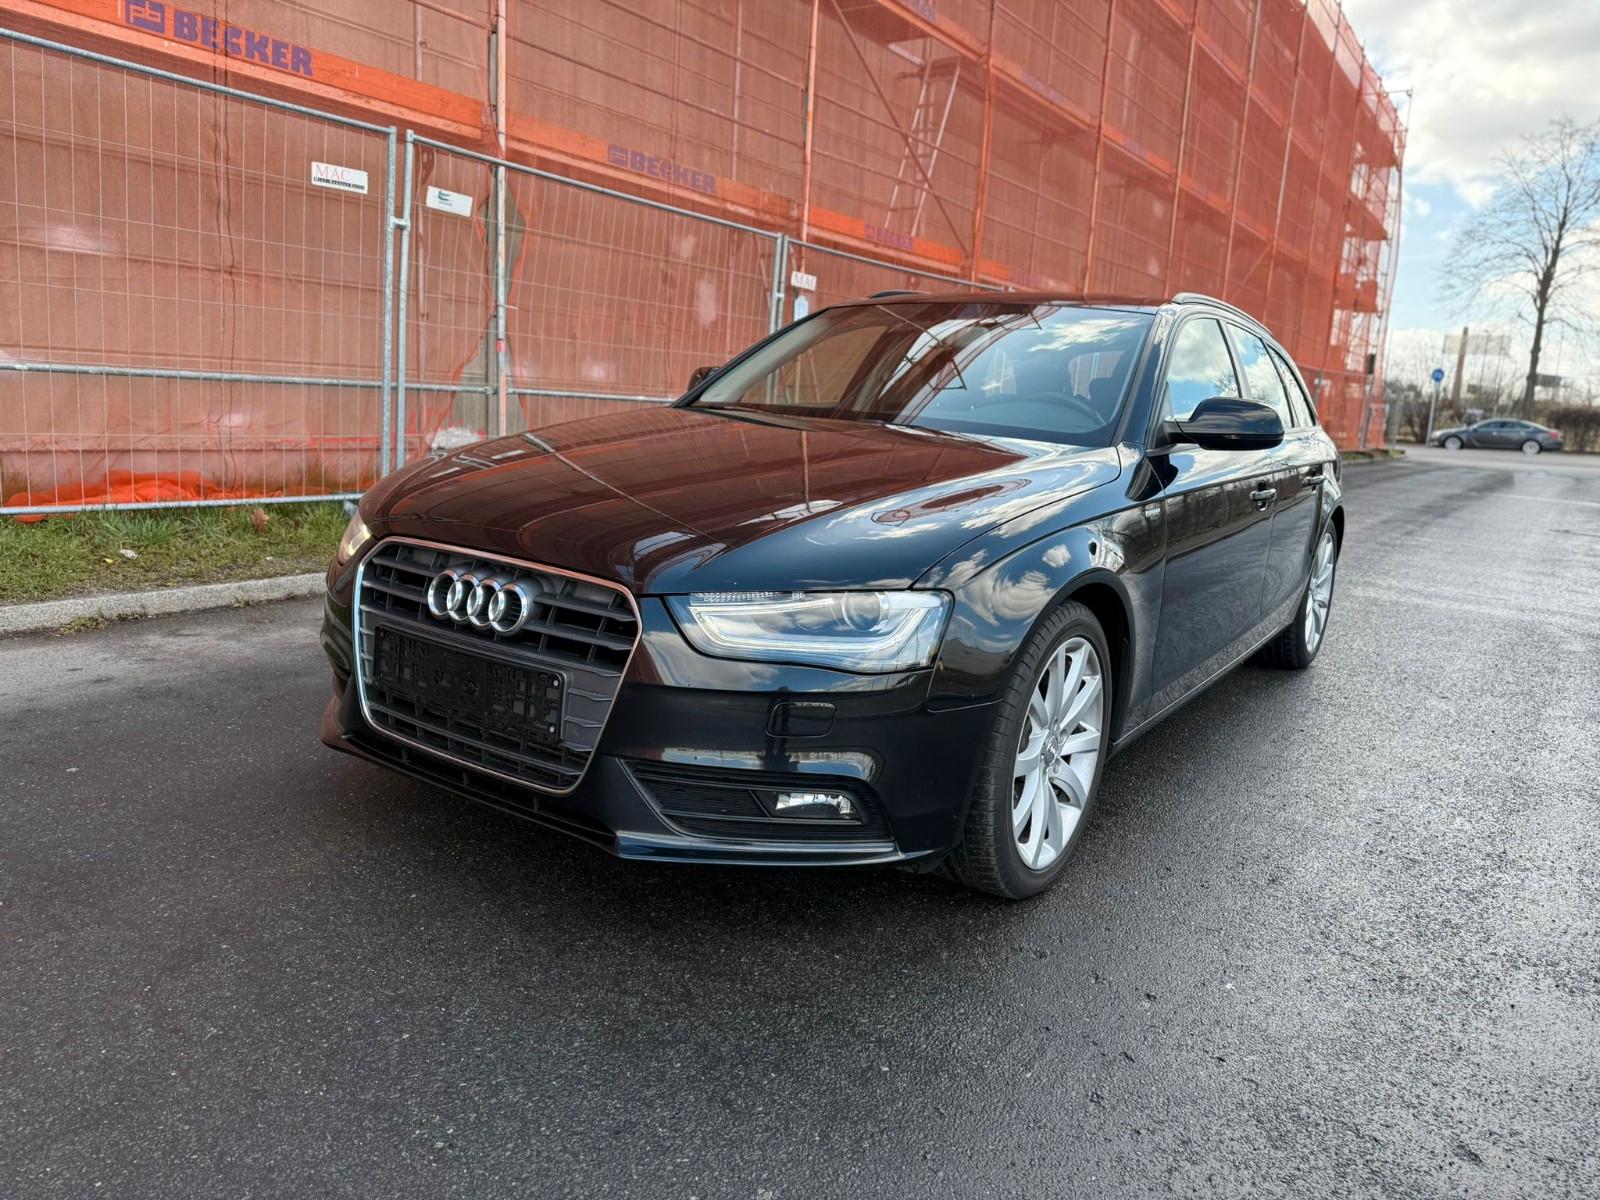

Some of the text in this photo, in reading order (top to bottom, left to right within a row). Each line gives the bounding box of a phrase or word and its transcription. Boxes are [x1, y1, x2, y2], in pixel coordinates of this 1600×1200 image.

[173, 9, 313, 77] BECKER
[314, 164, 353, 181] MAC
[630, 149, 717, 194] BECKER
